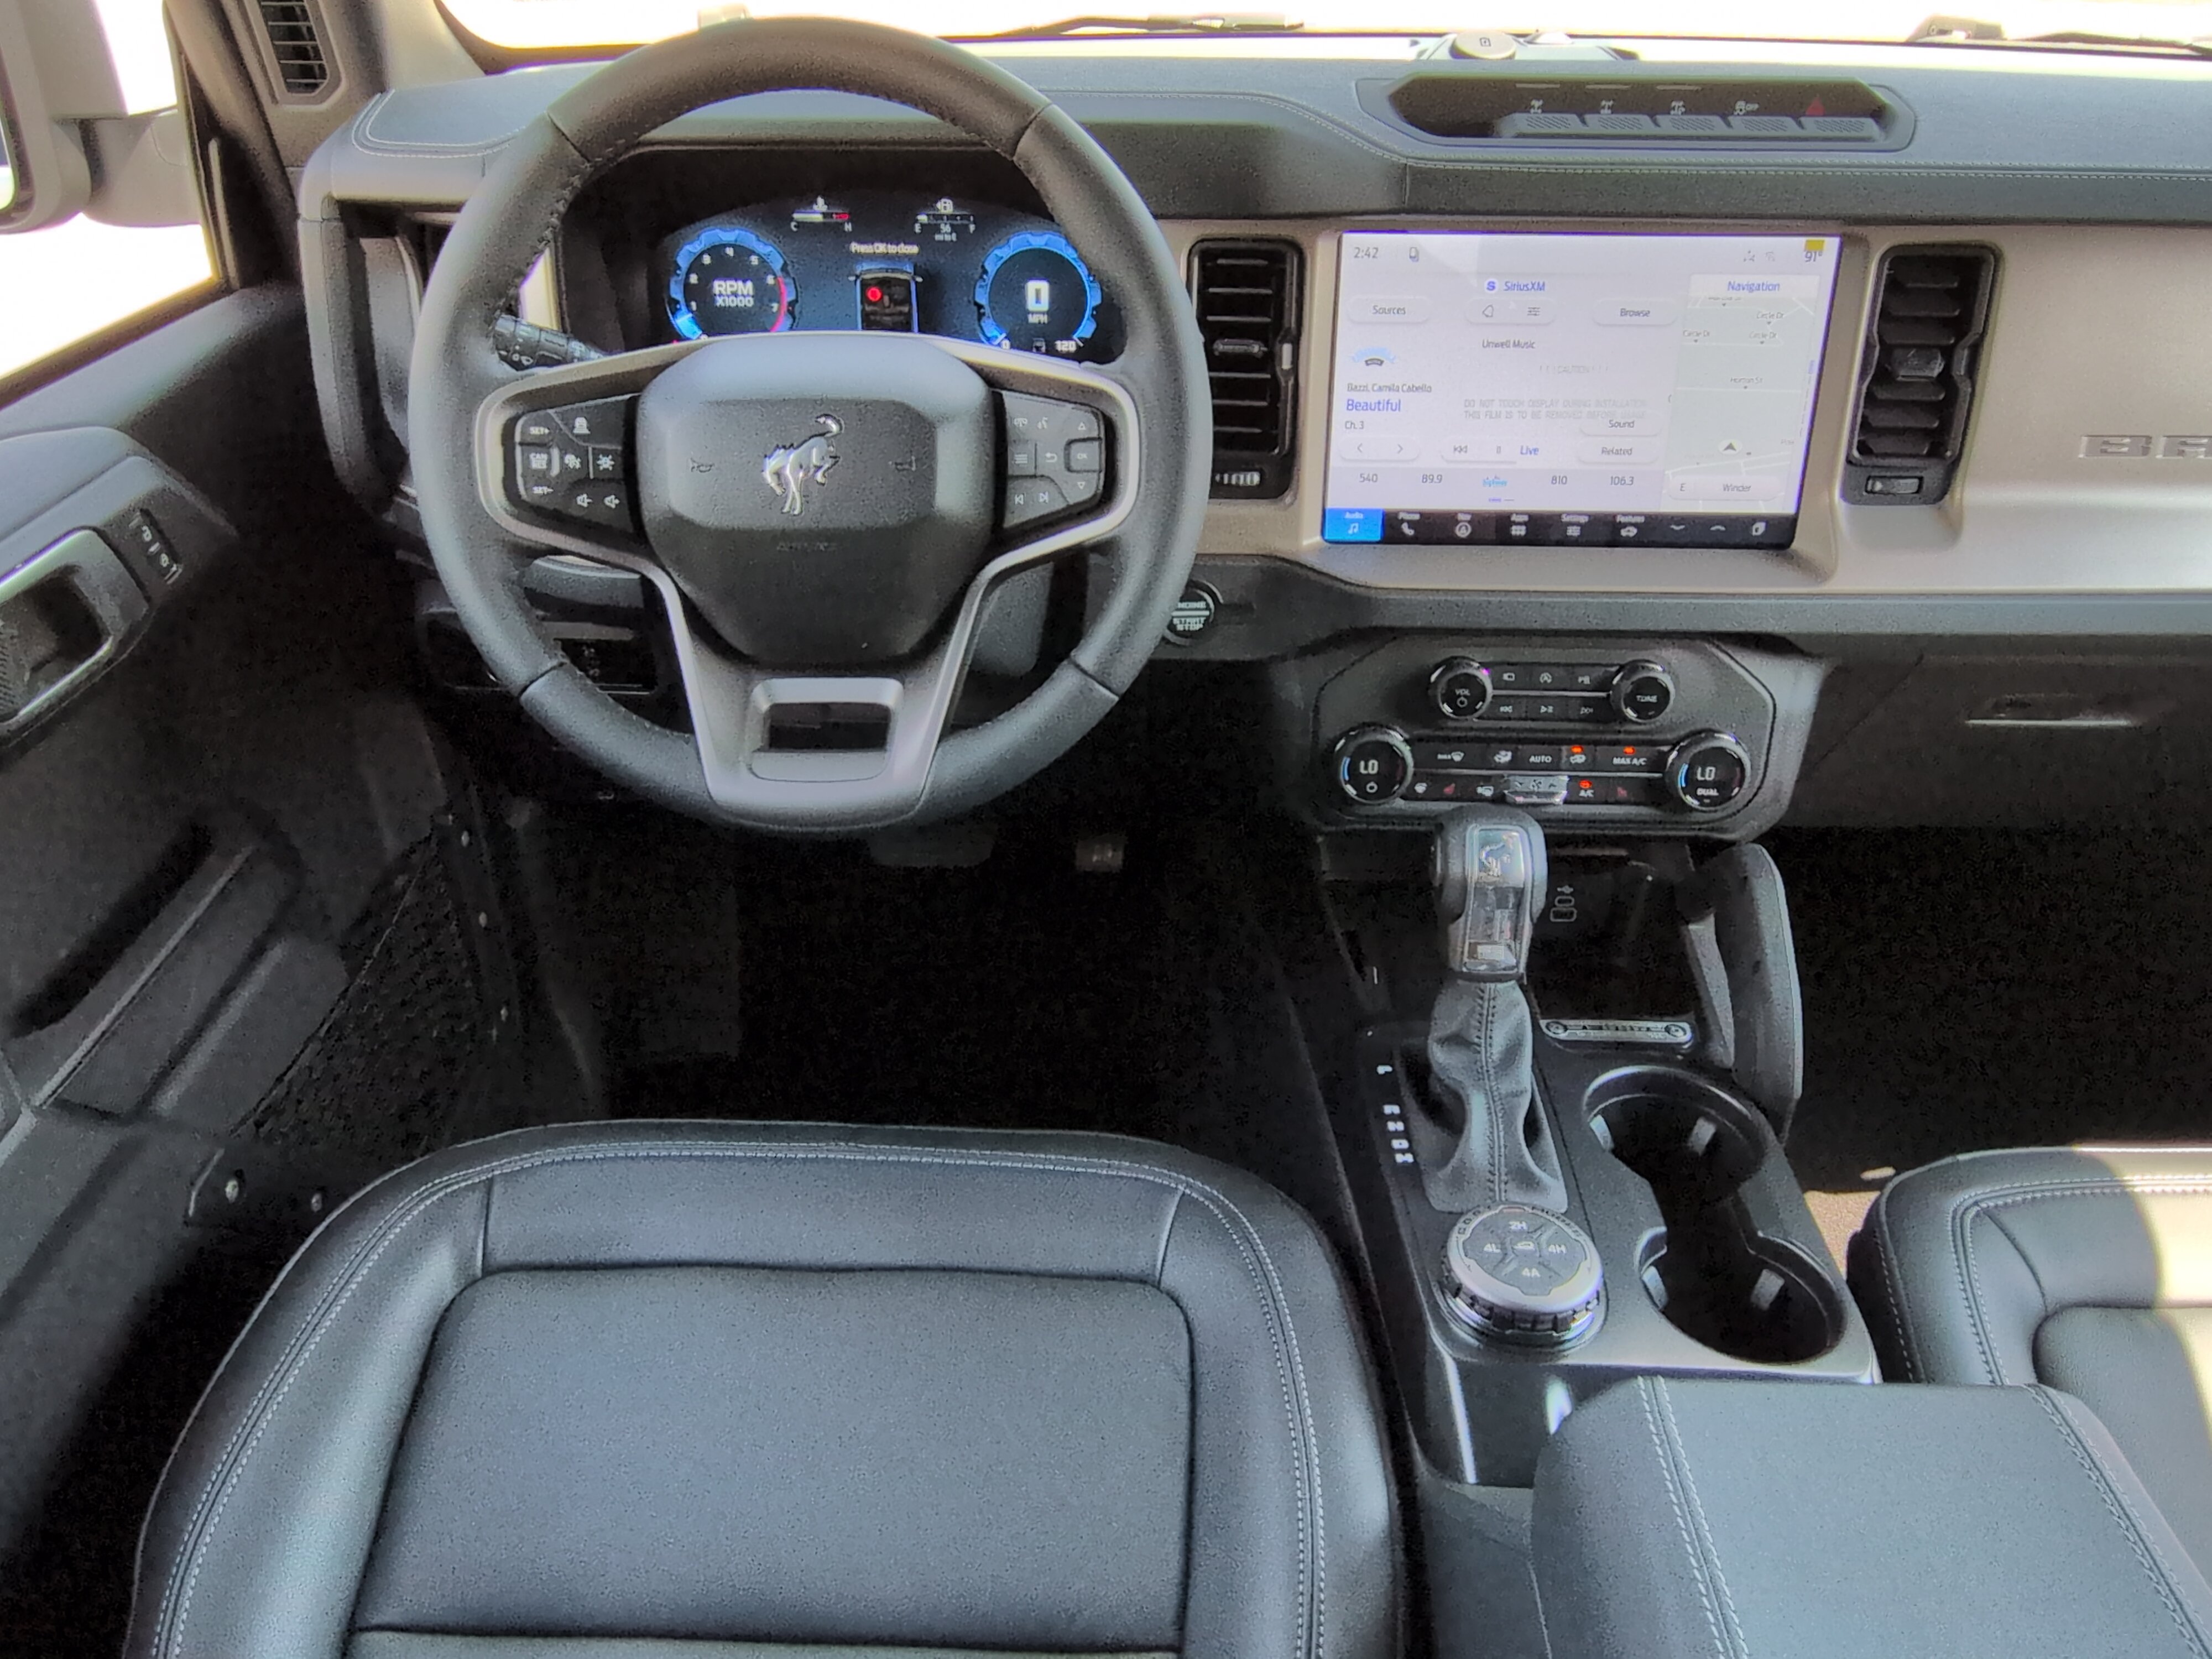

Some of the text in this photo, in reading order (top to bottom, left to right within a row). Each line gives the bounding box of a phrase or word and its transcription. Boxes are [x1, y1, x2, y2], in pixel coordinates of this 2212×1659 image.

[1354, 247, 1379, 259] 2:42
[713, 279, 753, 295] RPM
[1504, 281, 1545, 291] SiriusXM
[1727, 280, 1780, 293] Navigation
[1026, 280, 1050, 312] 0
[1372, 305, 1406, 315] Sources
[1620, 308, 1650, 317] Browse
[1027, 313, 1048, 324] MPH
[1055, 340, 1076, 352] 120
[1512, 340, 1535, 349] Music
[1371, 383, 1399, 393] Camila
[1401, 384, 1432, 393] Cabello
[1346, 399, 1401, 412] Beautiful
[1608, 419, 1635, 429] Sound
[1520, 446, 1539, 455] Live
[1601, 446, 1632, 456] Related
[1359, 474, 1378, 483] 540
[1421, 474, 1442, 483] 89.9
[1551, 476, 1567, 485] 810
[1610, 476, 1634, 486] 106.3
[1680, 483, 1686, 492] E
[1723, 483, 1751, 492] Winder
[1360, 759, 1379, 774] LO
[1697, 766, 1716, 781] LO
[1522, 1267, 1541, 1277] 4A
